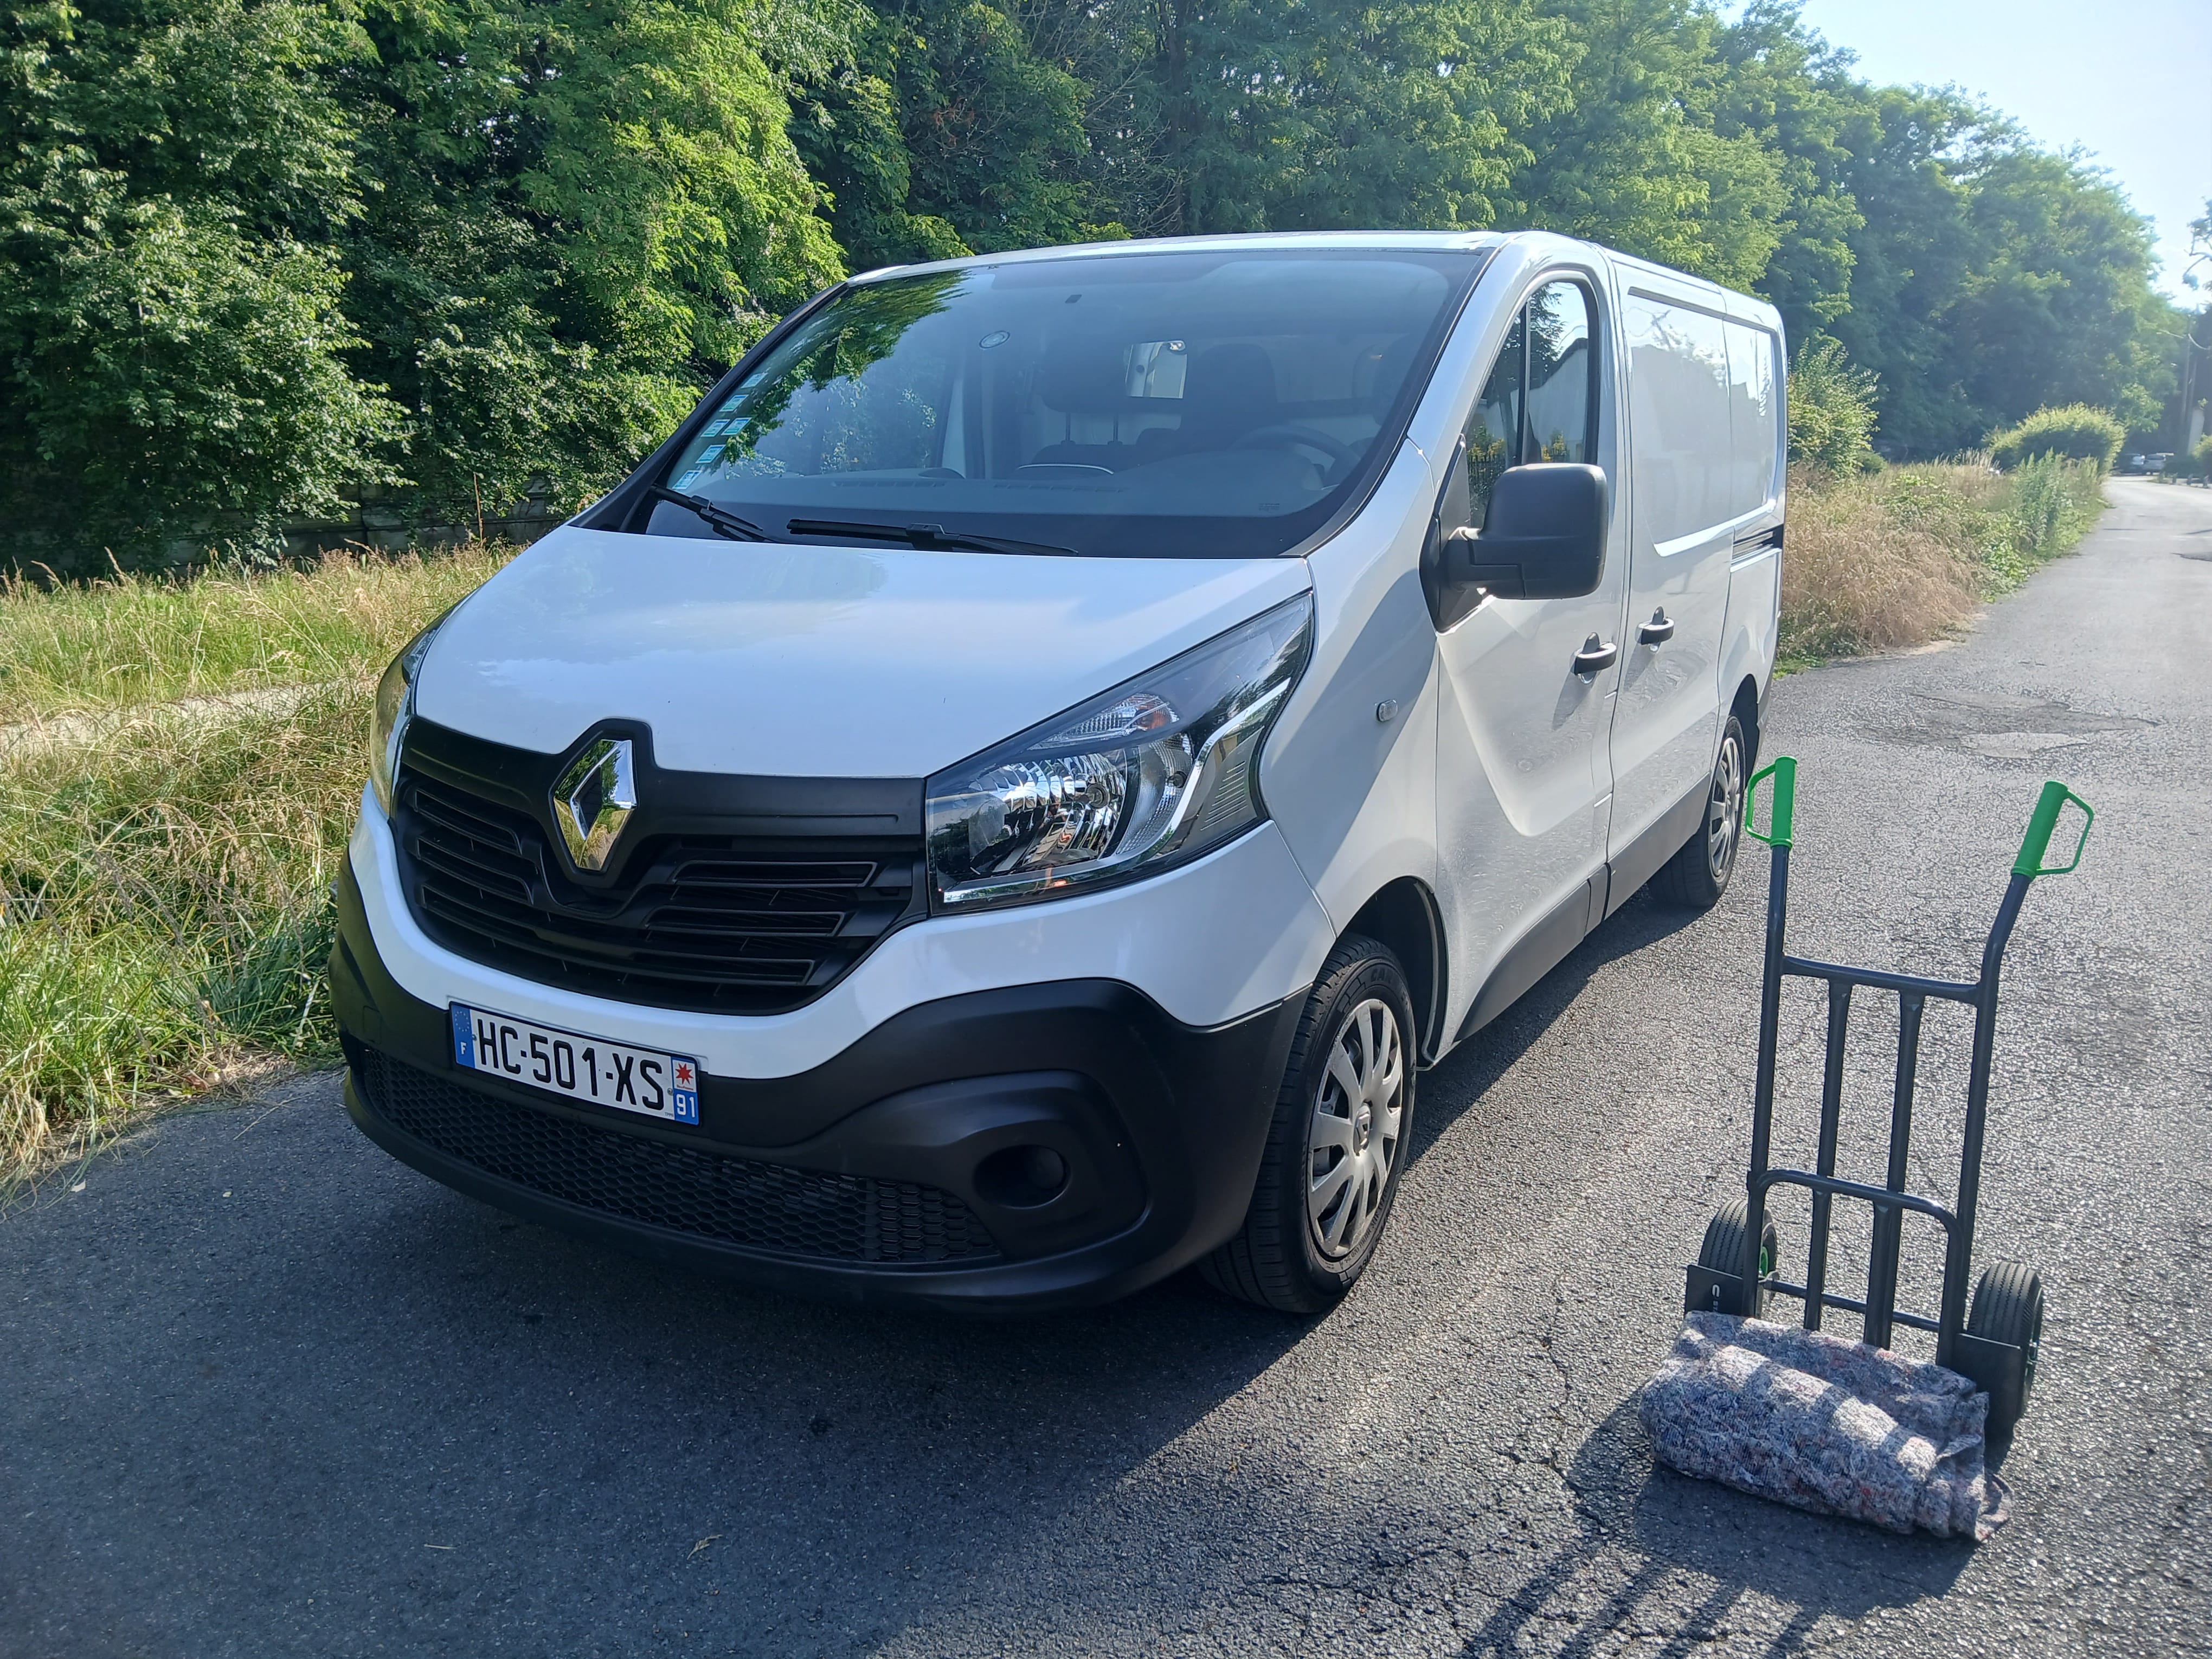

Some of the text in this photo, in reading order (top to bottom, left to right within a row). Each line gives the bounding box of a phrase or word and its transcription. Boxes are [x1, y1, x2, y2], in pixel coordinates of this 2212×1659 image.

[460, 1041, 467, 1055] F
[477, 1018, 665, 1111] HC-501-XS
[676, 1094, 695, 1118] 91
